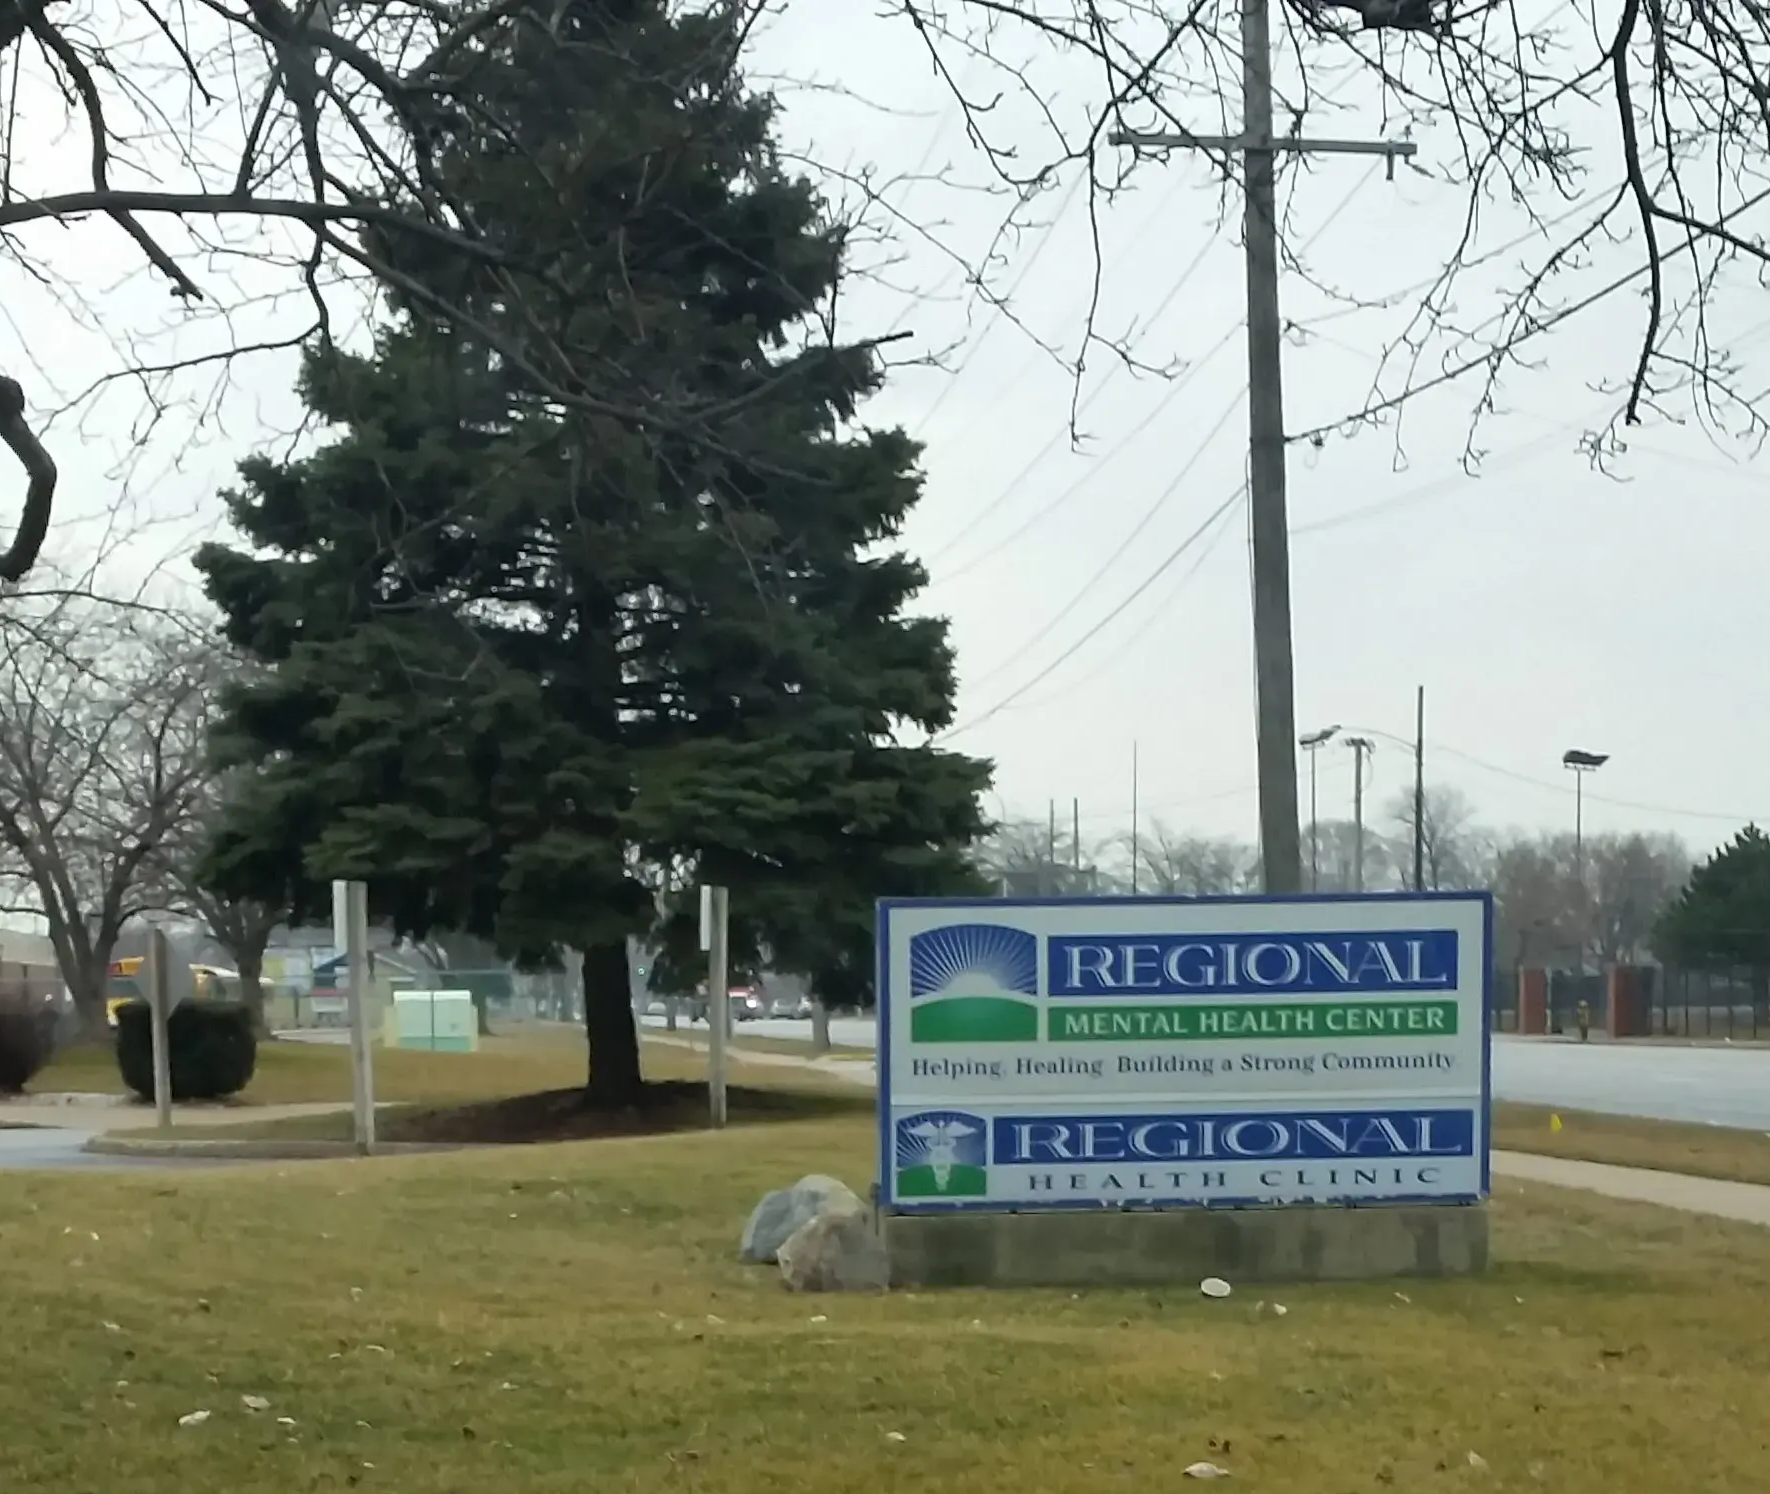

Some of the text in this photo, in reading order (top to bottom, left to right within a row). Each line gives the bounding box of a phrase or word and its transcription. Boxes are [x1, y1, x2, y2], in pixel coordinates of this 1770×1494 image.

[1064, 940, 1448, 988] REGIONAL
[1065, 1006, 1446, 1035] MENTAL HEALTH CENTER
[1117, 1055, 1214, 1074] Building
[1220, 1059, 1233, 1071] a
[1240, 1053, 1316, 1074] Strong
[1322, 1052, 1454, 1074] Community
[1012, 1116, 1463, 1161] REGIONAL
[1029, 1167, 1443, 1191] HEALTH CLINIC
